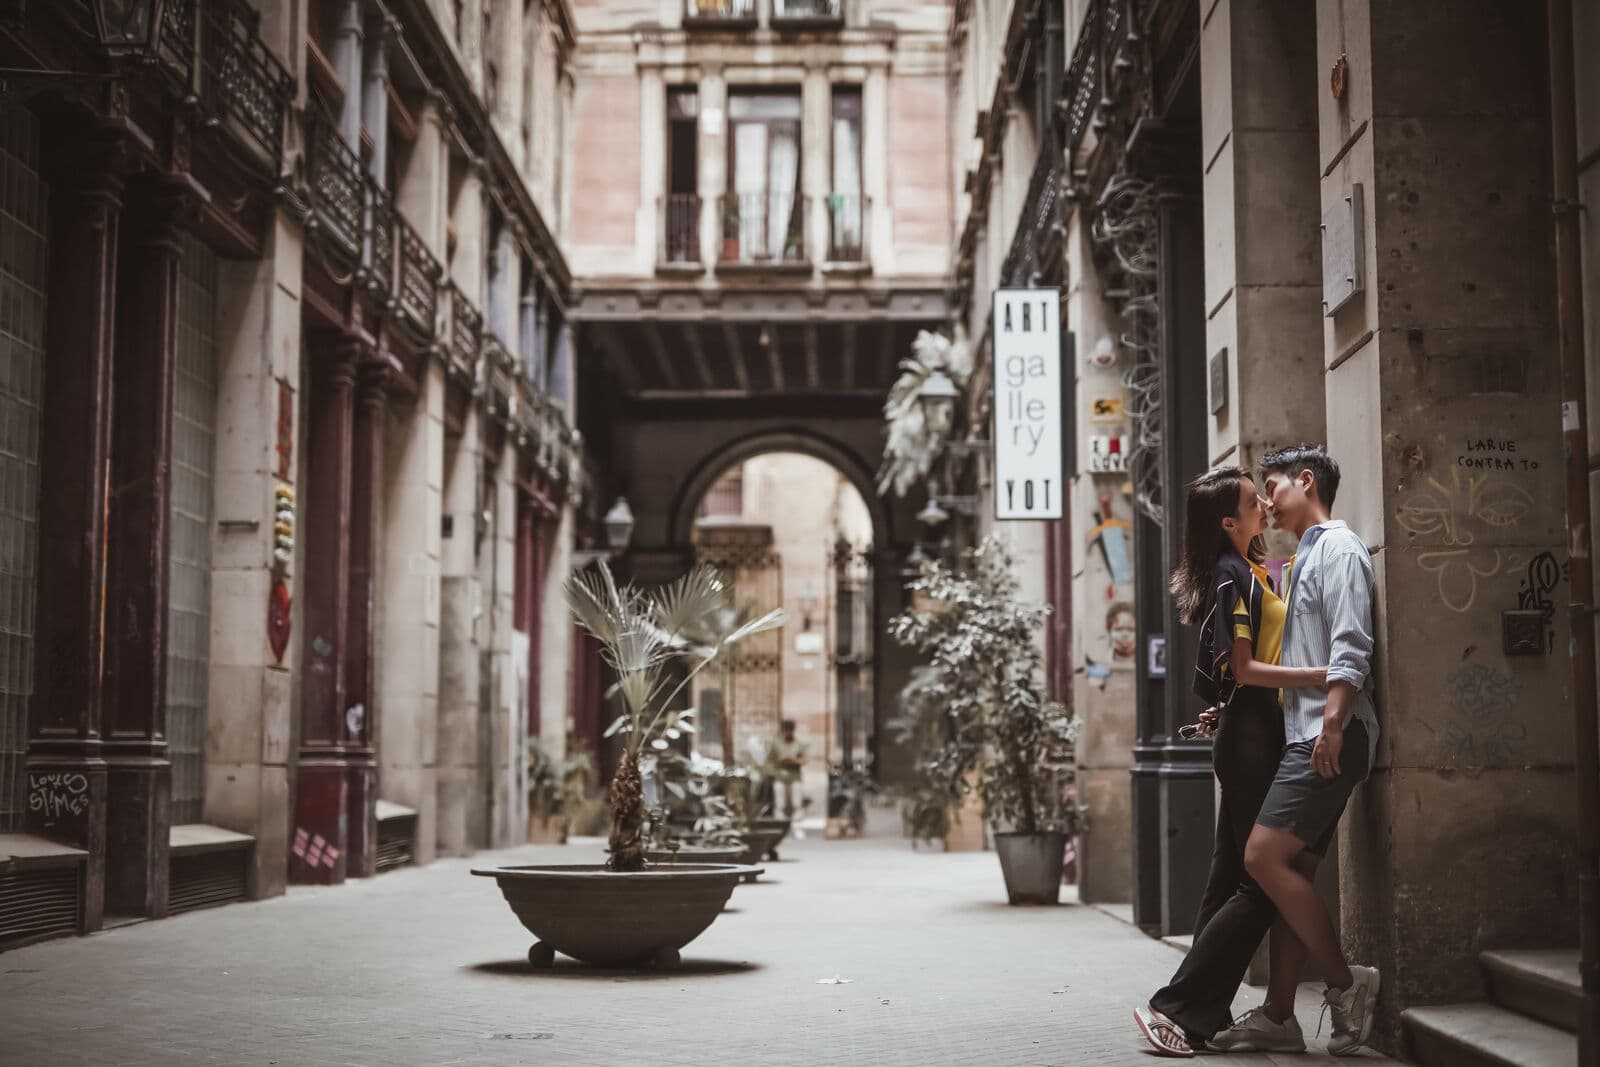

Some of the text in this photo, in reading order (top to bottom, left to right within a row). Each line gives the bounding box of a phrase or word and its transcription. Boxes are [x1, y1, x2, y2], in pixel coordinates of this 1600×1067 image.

[1004, 302, 1048, 332] ART
[1005, 355, 1046, 388] ga
[1008, 390, 1046, 421] lle
[1013, 423, 1045, 456] ry
[1458, 455, 1514, 470] CONTRA
[1006, 479, 1051, 511] YOT
